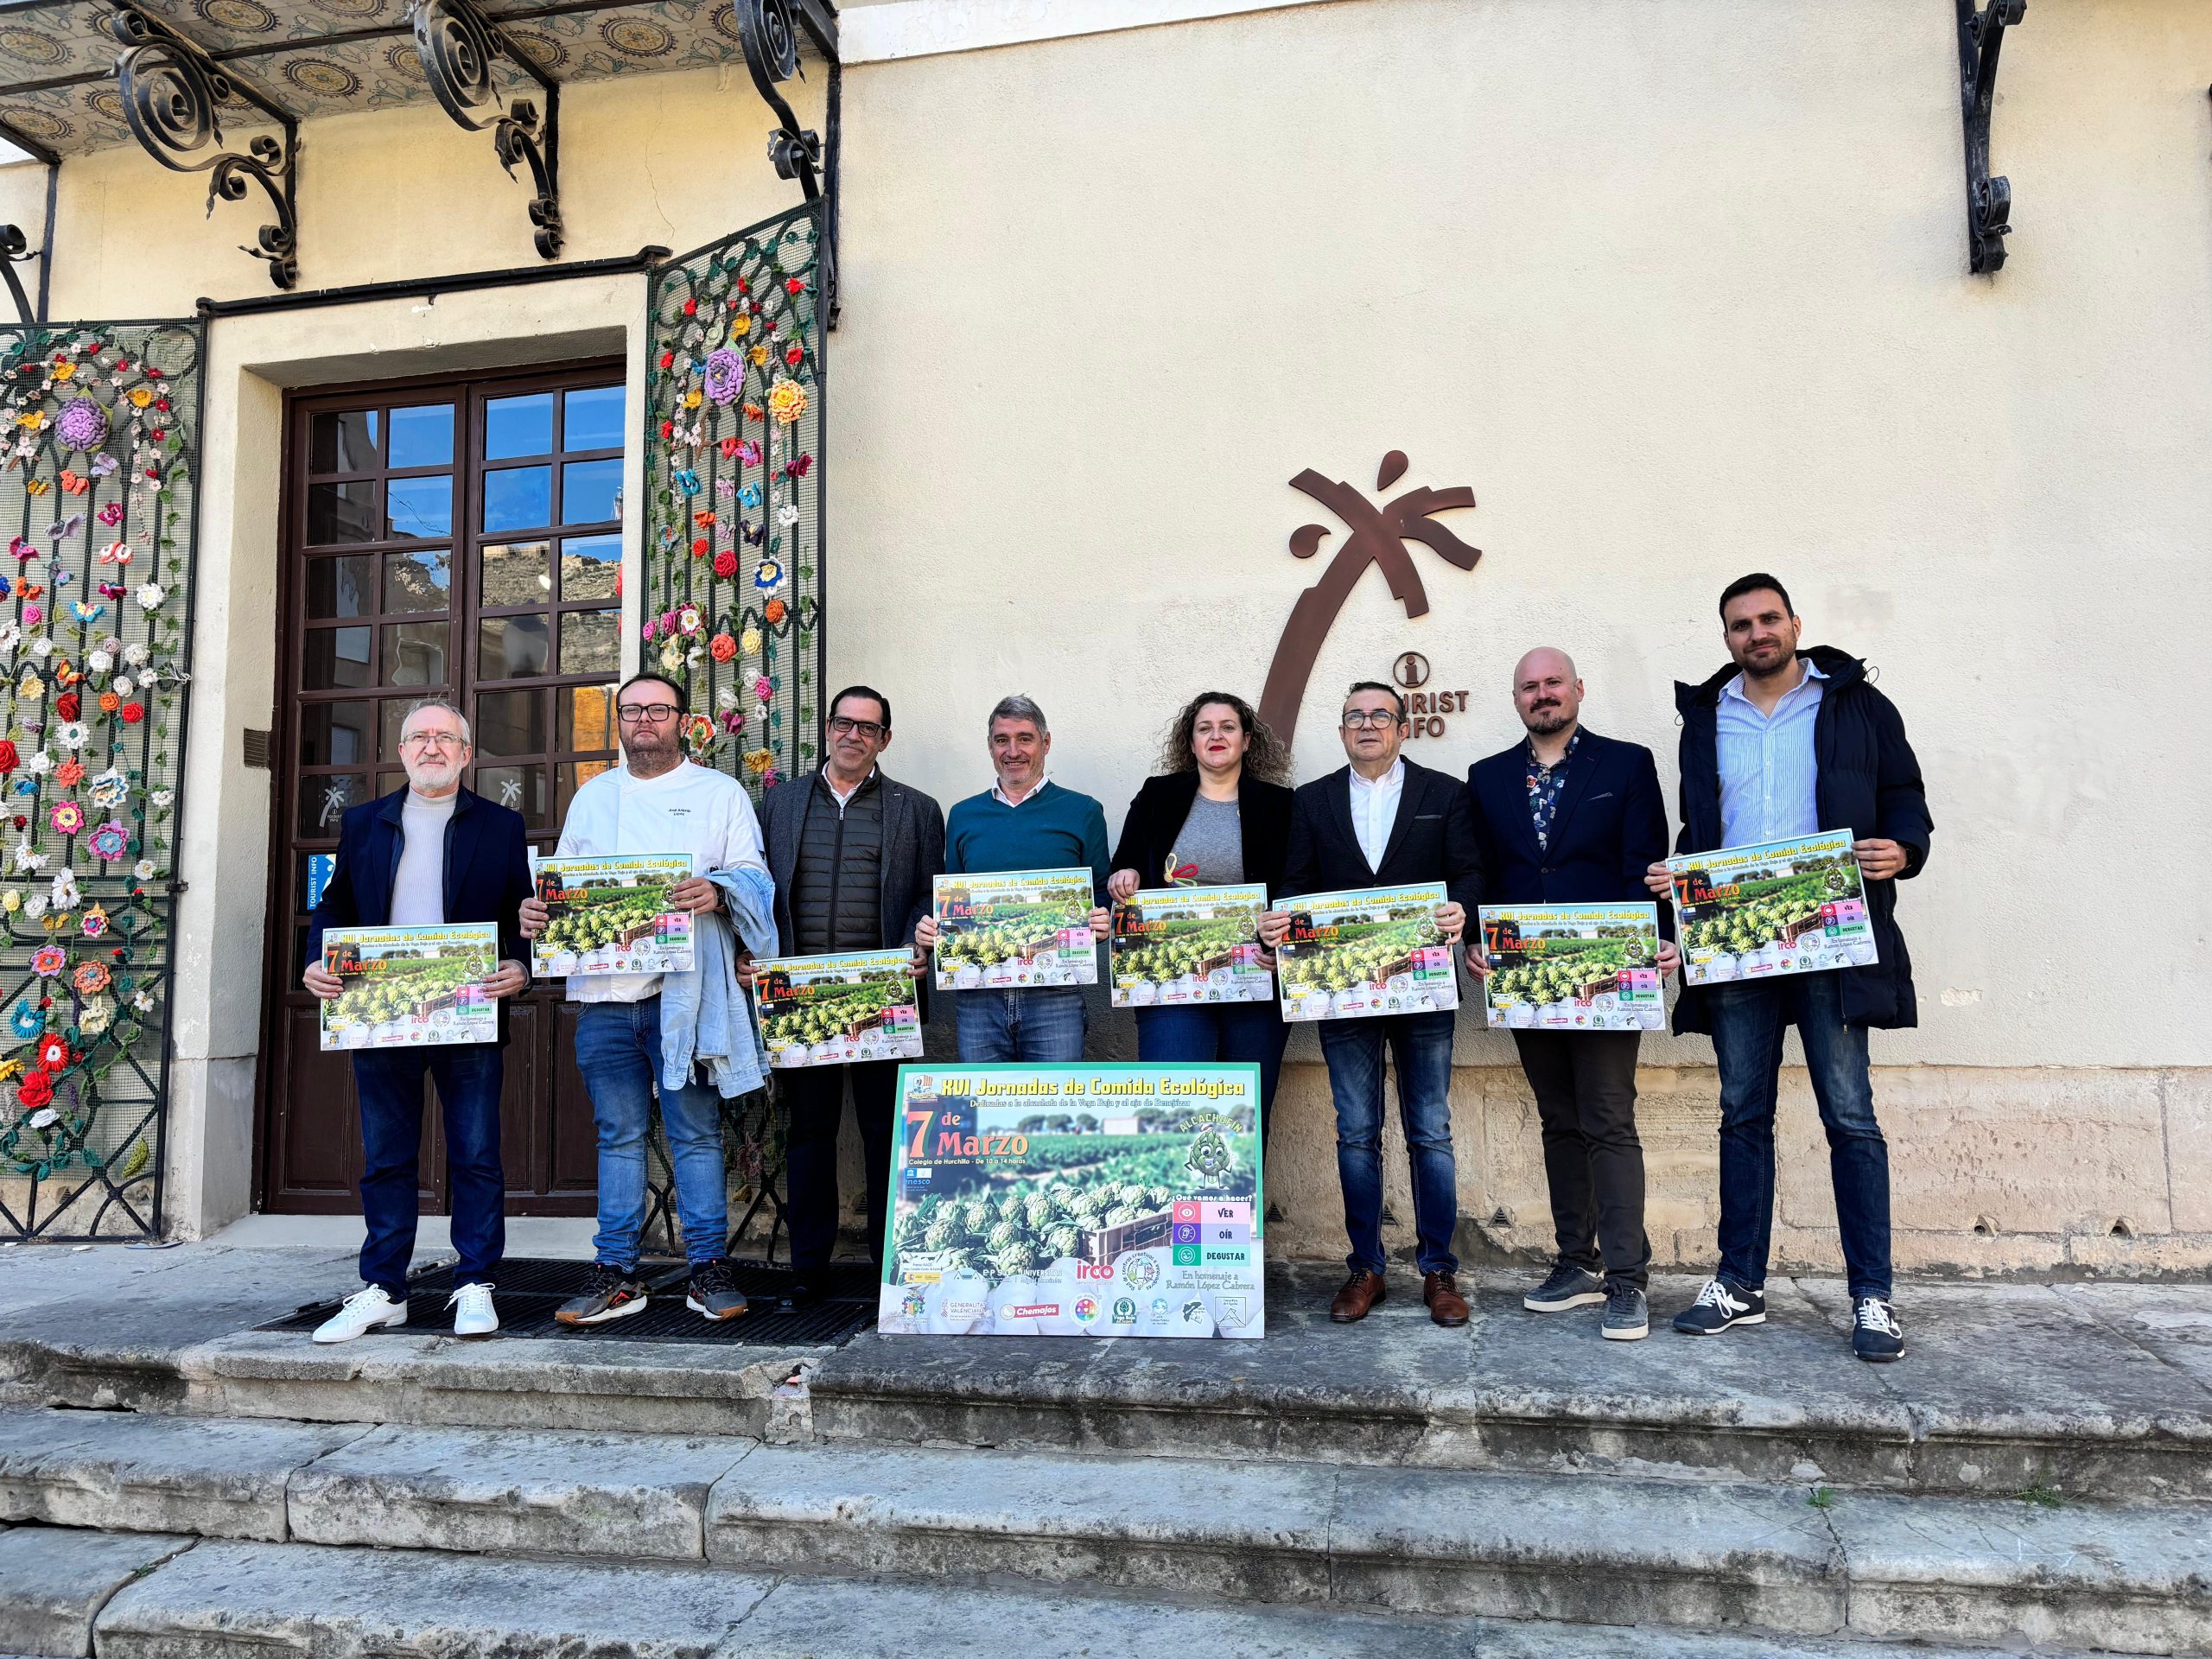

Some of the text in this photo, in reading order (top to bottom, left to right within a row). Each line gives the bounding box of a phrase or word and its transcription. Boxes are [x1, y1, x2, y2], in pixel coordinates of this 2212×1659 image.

[1404, 690, 1469, 714] RIST
[1407, 715, 1445, 739] FO
[1706, 853, 1748, 868] Jornadas
[1750, 851, 1762, 861] de
[1764, 846, 1798, 859] Comida
[560, 862, 599, 871] Jornadas
[601, 861, 612, 869] de
[613, 860, 644, 868] Comida
[969, 879, 1005, 888] Jornadas
[1020, 877, 1048, 886] Comida
[536, 880, 543, 901] 7
[546, 888, 588, 900] Marzo
[1675, 880, 1691, 904] 7
[1694, 883, 1740, 900] Marzo
[1140, 895, 1177, 905] Jornadas
[1192, 893, 1220, 901] Comida
[1309, 899, 1349, 910] Jornadas
[1351, 897, 1362, 906] de
[1363, 894, 1395, 904] Comida
[939, 896, 951, 917] 7
[953, 904, 994, 915] Marzo
[1516, 911, 1557, 919] Jornadas
[1560, 911, 1570, 919] de
[1573, 911, 1605, 919] Comida
[1114, 912, 1124, 934] 7
[1127, 920, 1166, 932] Marzo
[359, 932, 401, 943] Jornadas
[404, 932, 414, 941] de
[416, 931, 448, 940] Comida
[1294, 926, 1339, 939] Marzo
[1486, 928, 1498, 950] 7
[1503, 938, 1546, 949] Marzo
[1778, 939, 1797, 950] irco
[615, 943, 632, 951] irco
[327, 950, 339, 972] 7
[341, 959, 387, 971] Marzo
[787, 962, 824, 971] Jornadas
[838, 958, 867, 967] Comida
[1018, 957, 1033, 965] irco
[1192, 974, 1209, 982] irco
[758, 979, 770, 1000] 7
[772, 985, 816, 998] Marzo
[1370, 981, 1387, 990] irco
[1574, 998, 1592, 1007] irco
[412, 1014, 429, 1024] irco
[844, 1034, 860, 1043] irco
[941, 1077, 1245, 1099] XVI Jornadas de Comida Ecológica
[1078, 1099, 1096, 1108] Vega
[1096, 1099, 1114, 1108] Baja
[1130, 1099, 1141, 1108] ajo
[907, 1111, 961, 1157] 7 de
[937, 1132, 1029, 1156] Marzo
[1217, 1208, 1234, 1217] VER
[1219, 1229, 1233, 1239] OÍR
[1206, 1252, 1245, 1261] DEGUSTAR
[1077, 1260, 1115, 1280] irco
[1182, 1270, 1193, 1280] En
[1194, 1270, 1232, 1281] homenaje
[1166, 1280, 1255, 1291] Ramón López Cabrera
[1016, 1306, 1057, 1316] Chemajos
